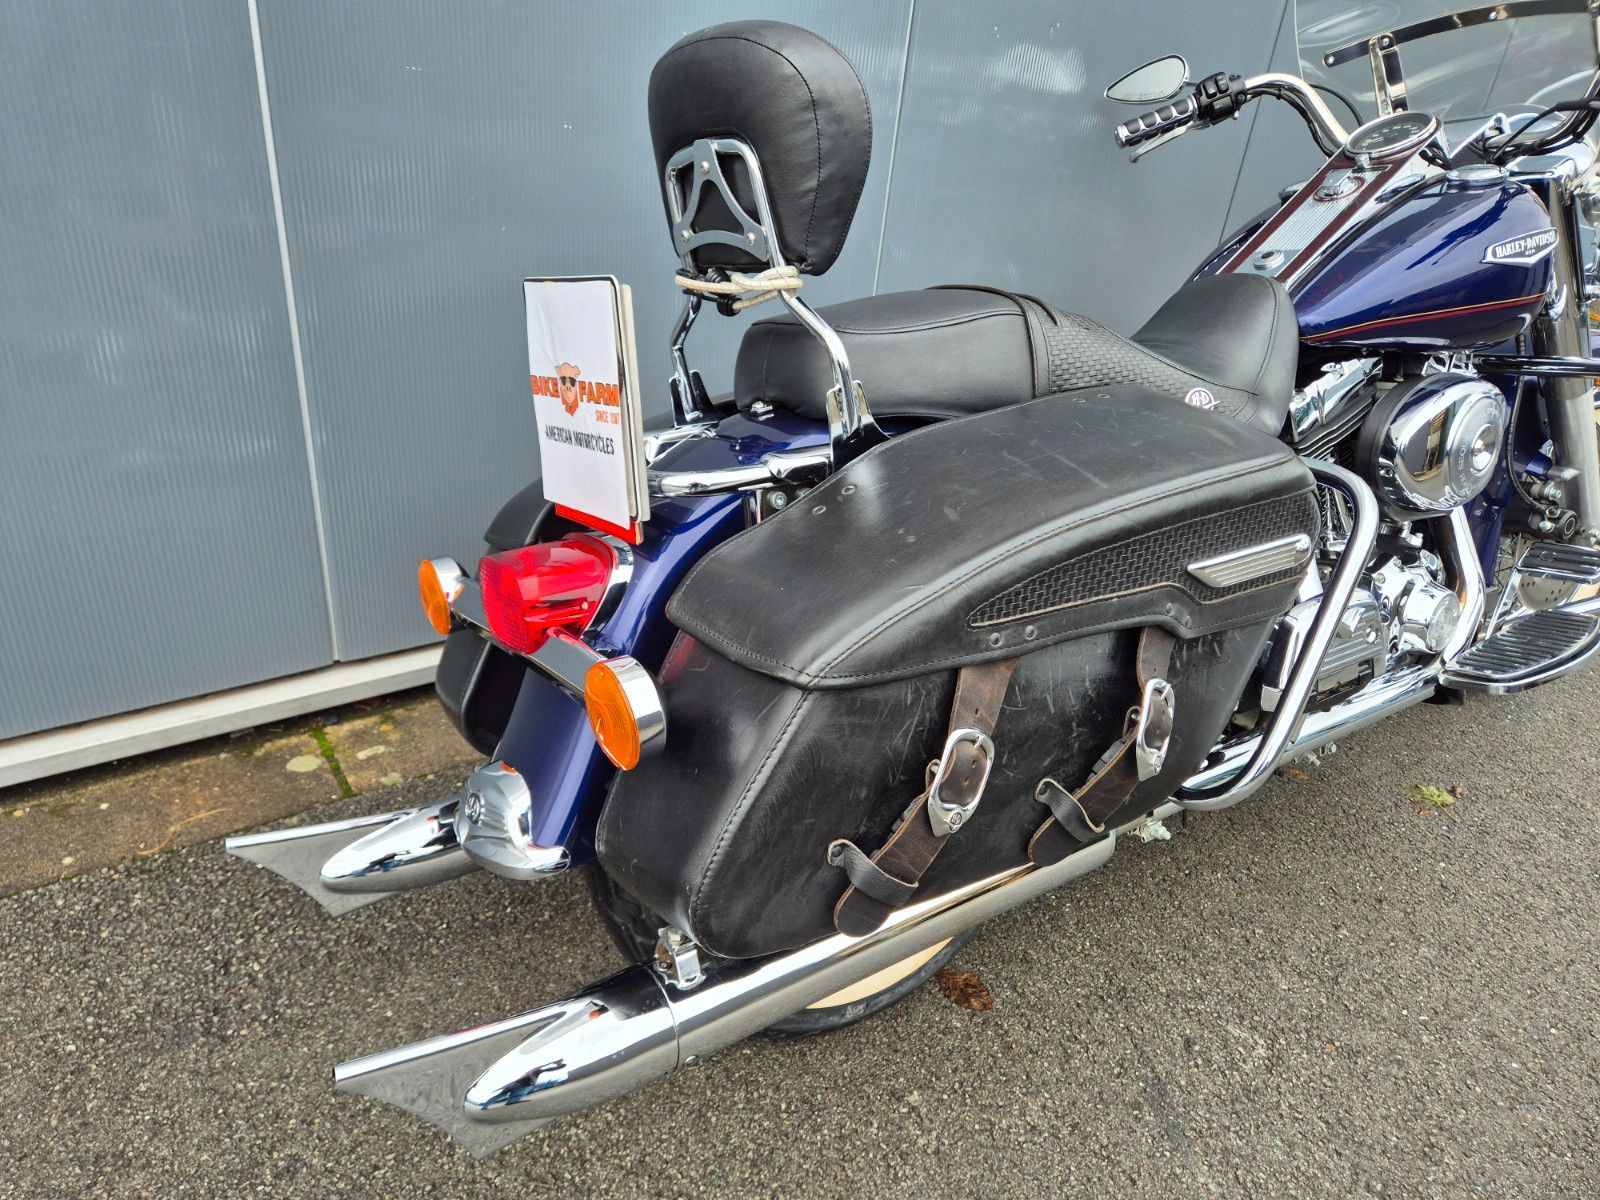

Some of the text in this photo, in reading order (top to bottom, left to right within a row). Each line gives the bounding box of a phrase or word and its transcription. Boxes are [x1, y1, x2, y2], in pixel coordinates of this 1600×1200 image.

[1495, 230, 1556, 258] HARLEY-DAVIDSON
[530, 374, 620, 407] BIKE FARM
[545, 424, 615, 455] AMERICAN MOTORCYCLES
